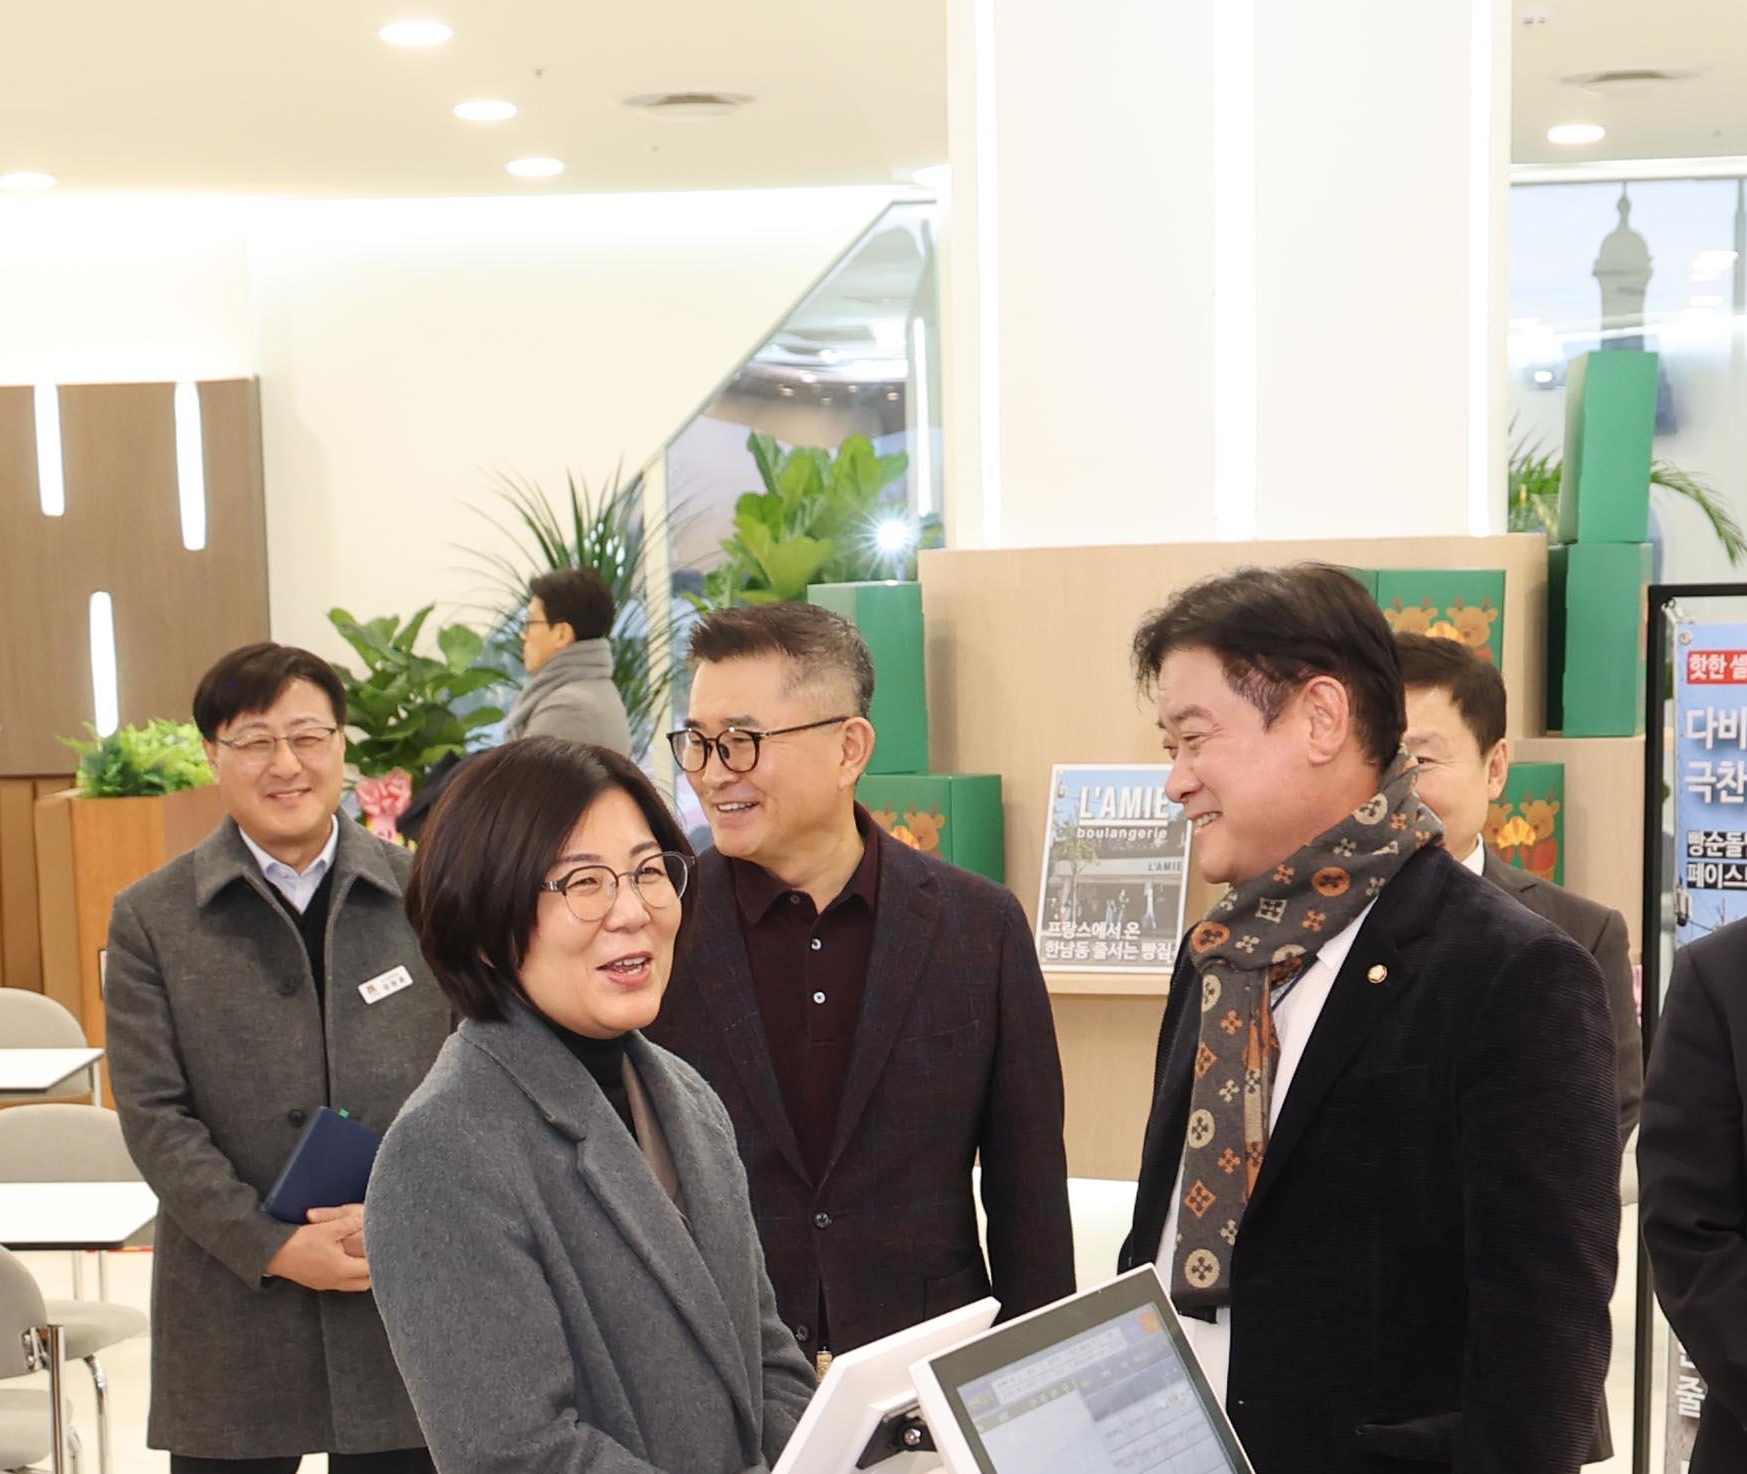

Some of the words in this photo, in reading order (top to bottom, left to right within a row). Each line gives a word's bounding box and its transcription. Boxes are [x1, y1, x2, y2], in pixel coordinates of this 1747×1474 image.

[1689, 654, 1726, 680] 핫한
[1079, 785, 1169, 819] L'AMIE
[1076, 826, 1168, 842] boulangerie
[1147, 860, 1183, 872] L'AMIE
[1045, 920, 1122, 941] 프랑스에서
[1123, 920, 1142, 941] 온
[1044, 942, 1090, 960] 한남동
